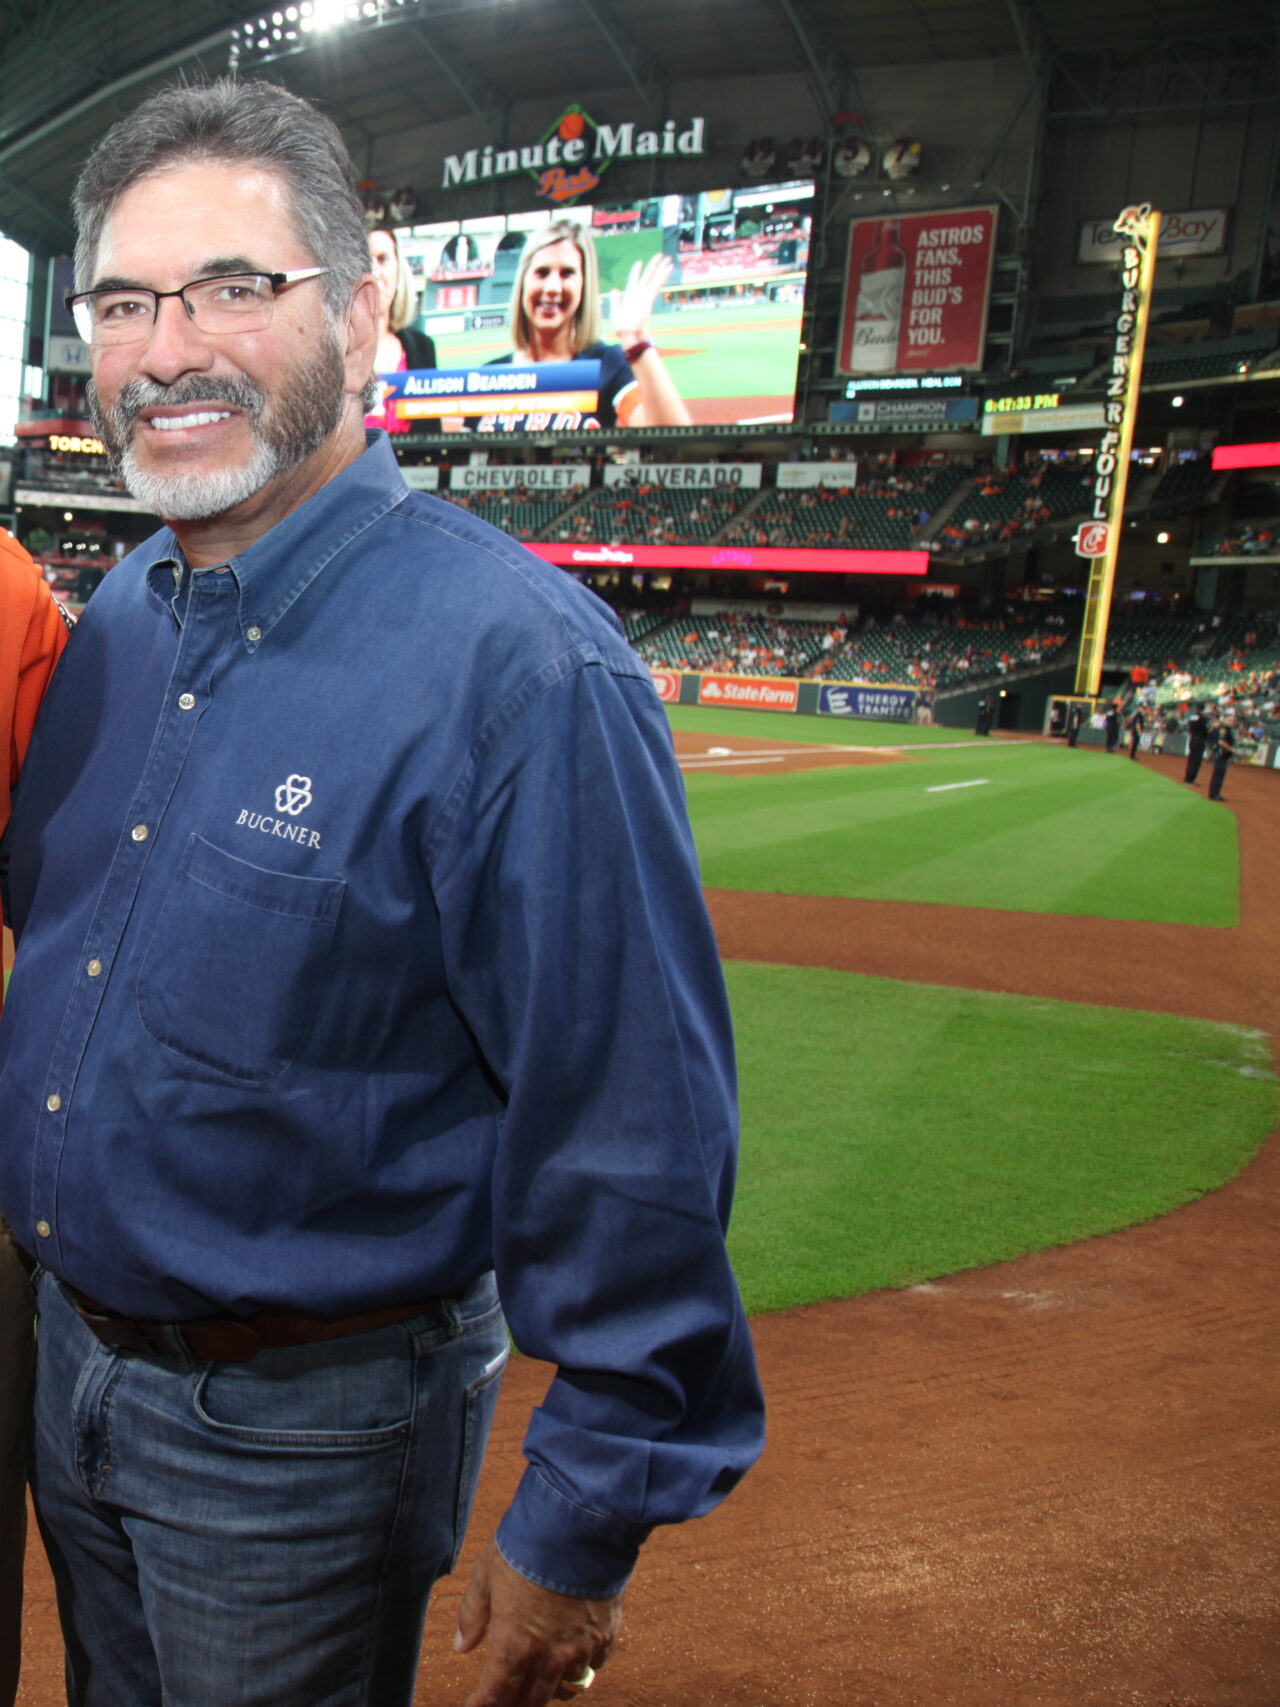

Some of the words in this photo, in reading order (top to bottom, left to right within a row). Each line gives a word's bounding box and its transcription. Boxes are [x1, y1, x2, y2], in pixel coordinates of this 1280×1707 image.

[441, 134, 585, 189] Minute
[593, 117, 705, 159] Maid
[536, 166, 600, 201] Park
[917, 225, 984, 248] ASTROS
[1166, 216, 1217, 244] Bay
[916, 247, 963, 268] FANS,
[914, 268, 952, 287] THIS
[911, 286, 963, 307] BUD'S
[909, 307, 943, 326] FOR
[908, 326, 946, 346] YOU.
[403, 375, 465, 395] ALLISON
[467, 372, 537, 392] BEARDEN
[877, 402, 947, 413] CHAMPION
[1034, 392, 1061, 409] PM
[464, 468, 577, 486] CHEVROLET
[623, 467, 744, 486] SILVERADO
[858, 692, 908, 706] ENERGY
[858, 704, 912, 718] TRANSFE
[235, 808, 323, 850] BUCKNER
